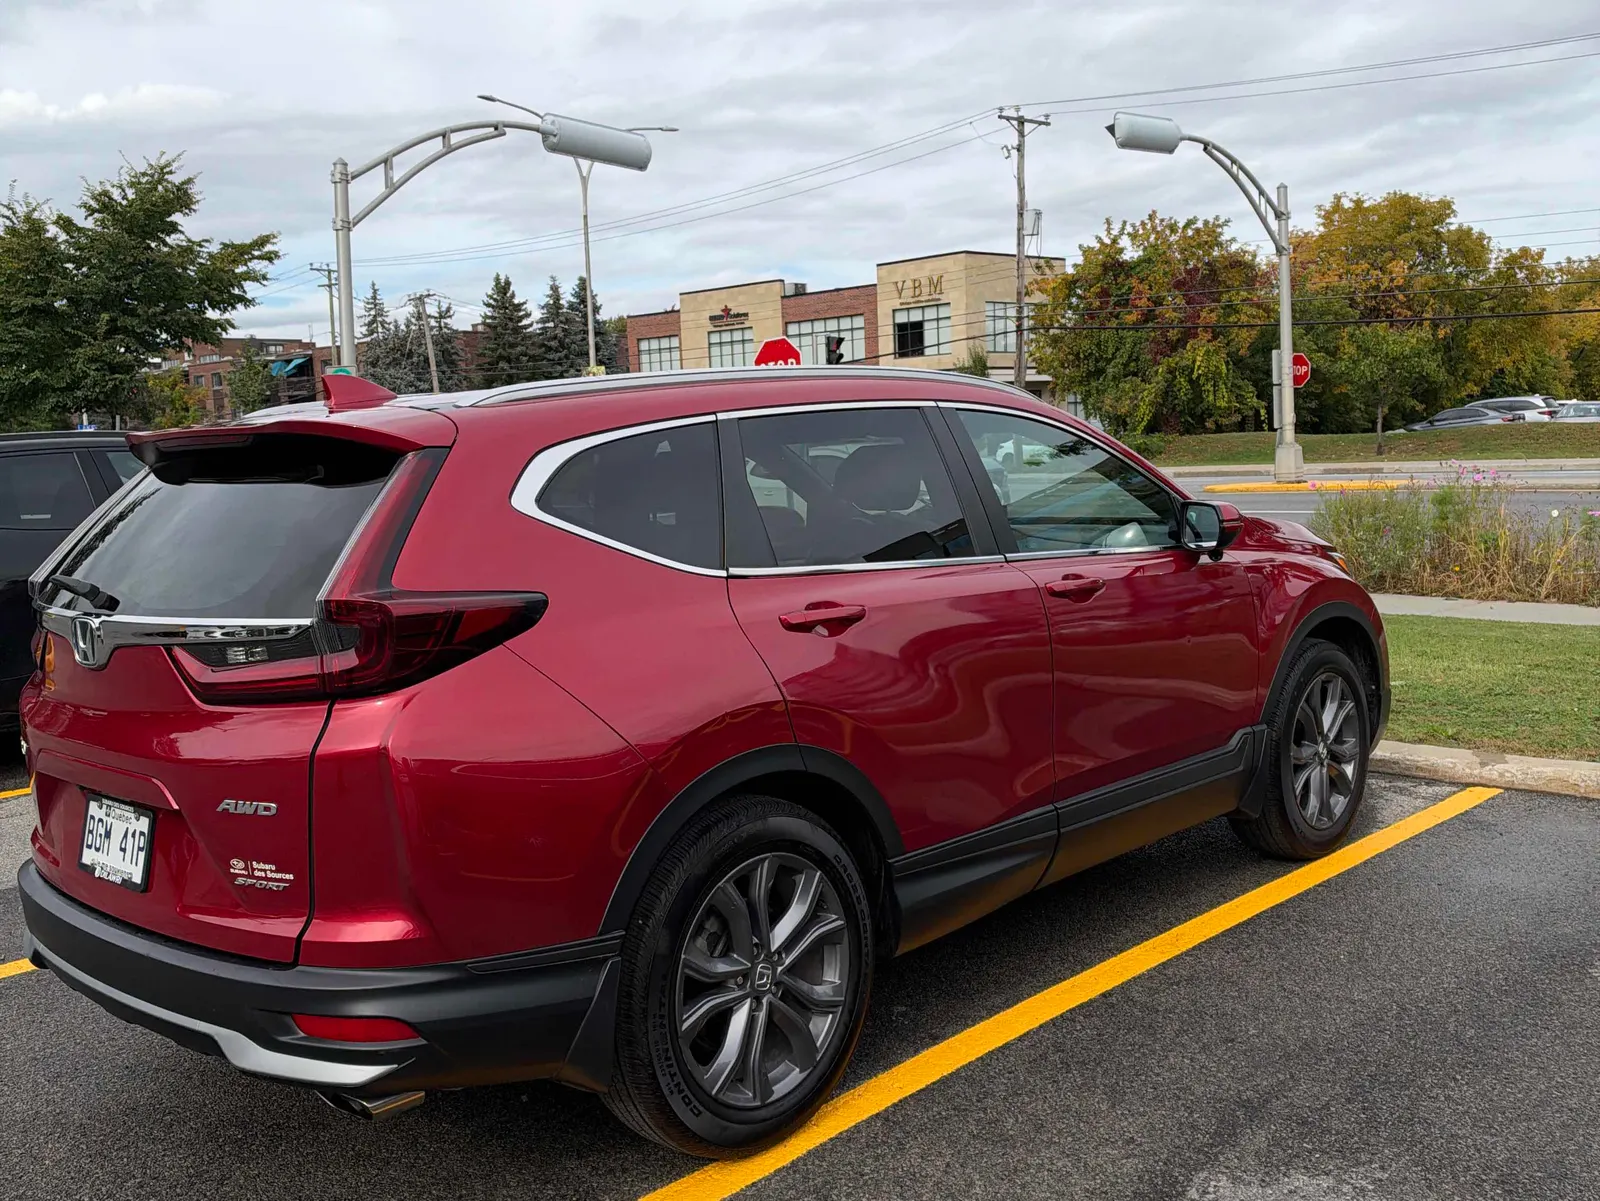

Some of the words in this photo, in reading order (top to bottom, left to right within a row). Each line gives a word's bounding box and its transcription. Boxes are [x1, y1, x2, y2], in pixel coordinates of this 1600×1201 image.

[892, 274, 944, 299] VBM
[215, 799, 278, 816] AWD
[85, 814, 113, 857] BGM
[119, 826, 146, 867] 41P
[252, 861, 276, 870] Subaru
[254, 869, 266, 877] des
[266, 870, 294, 880] Sources
[234, 877, 290, 891] SPORT
